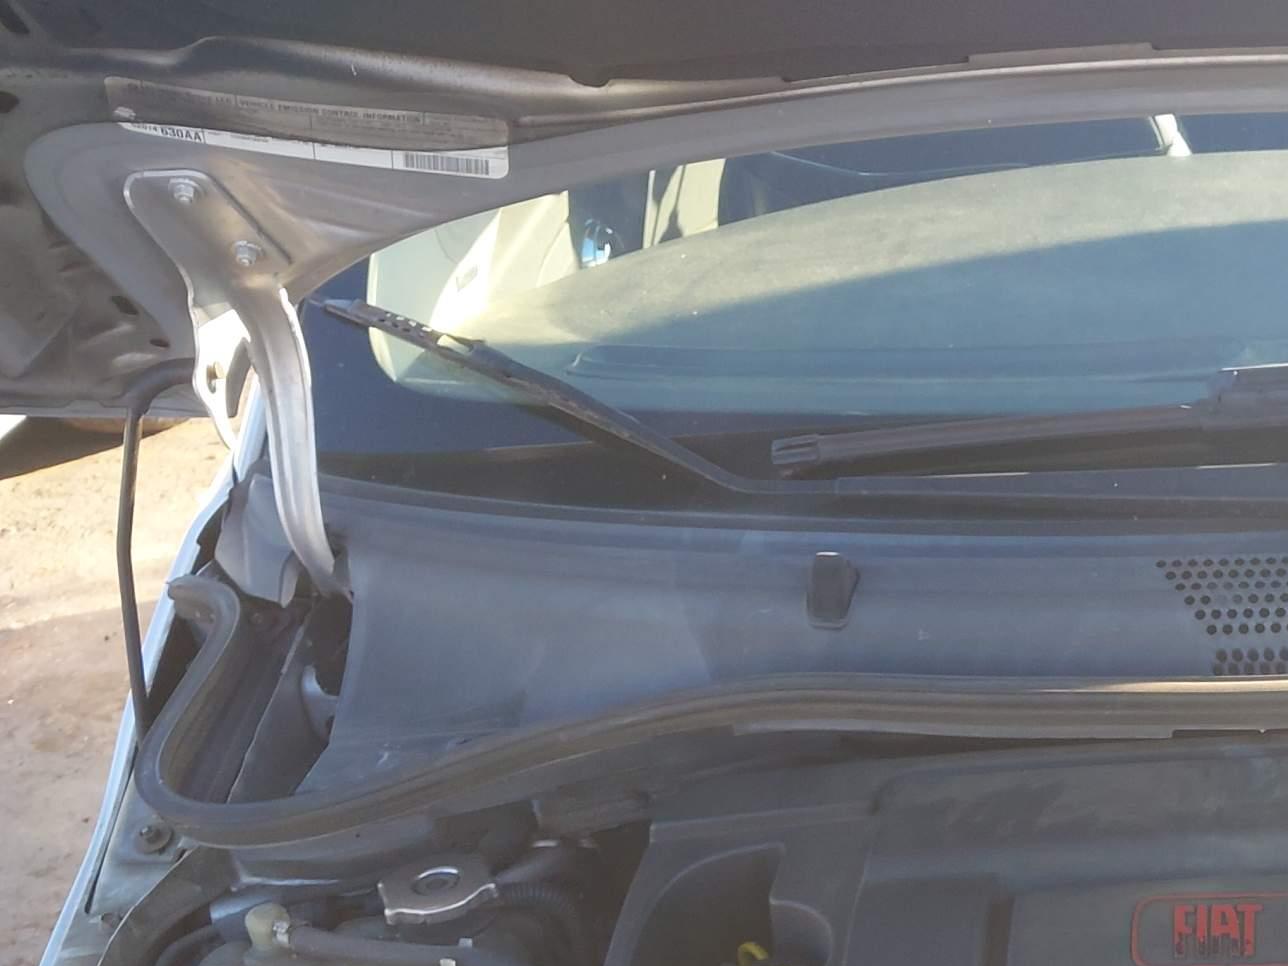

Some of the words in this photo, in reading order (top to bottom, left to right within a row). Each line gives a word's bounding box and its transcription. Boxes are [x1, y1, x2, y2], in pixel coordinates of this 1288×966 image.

[240, 99, 277, 110] VEHICLE
[277, 103, 318, 114] EMISSION
[321, 108, 359, 118] CONTROL
[362, 111, 421, 122] INFORMATION
[1173, 903, 1265, 957] FIAT
